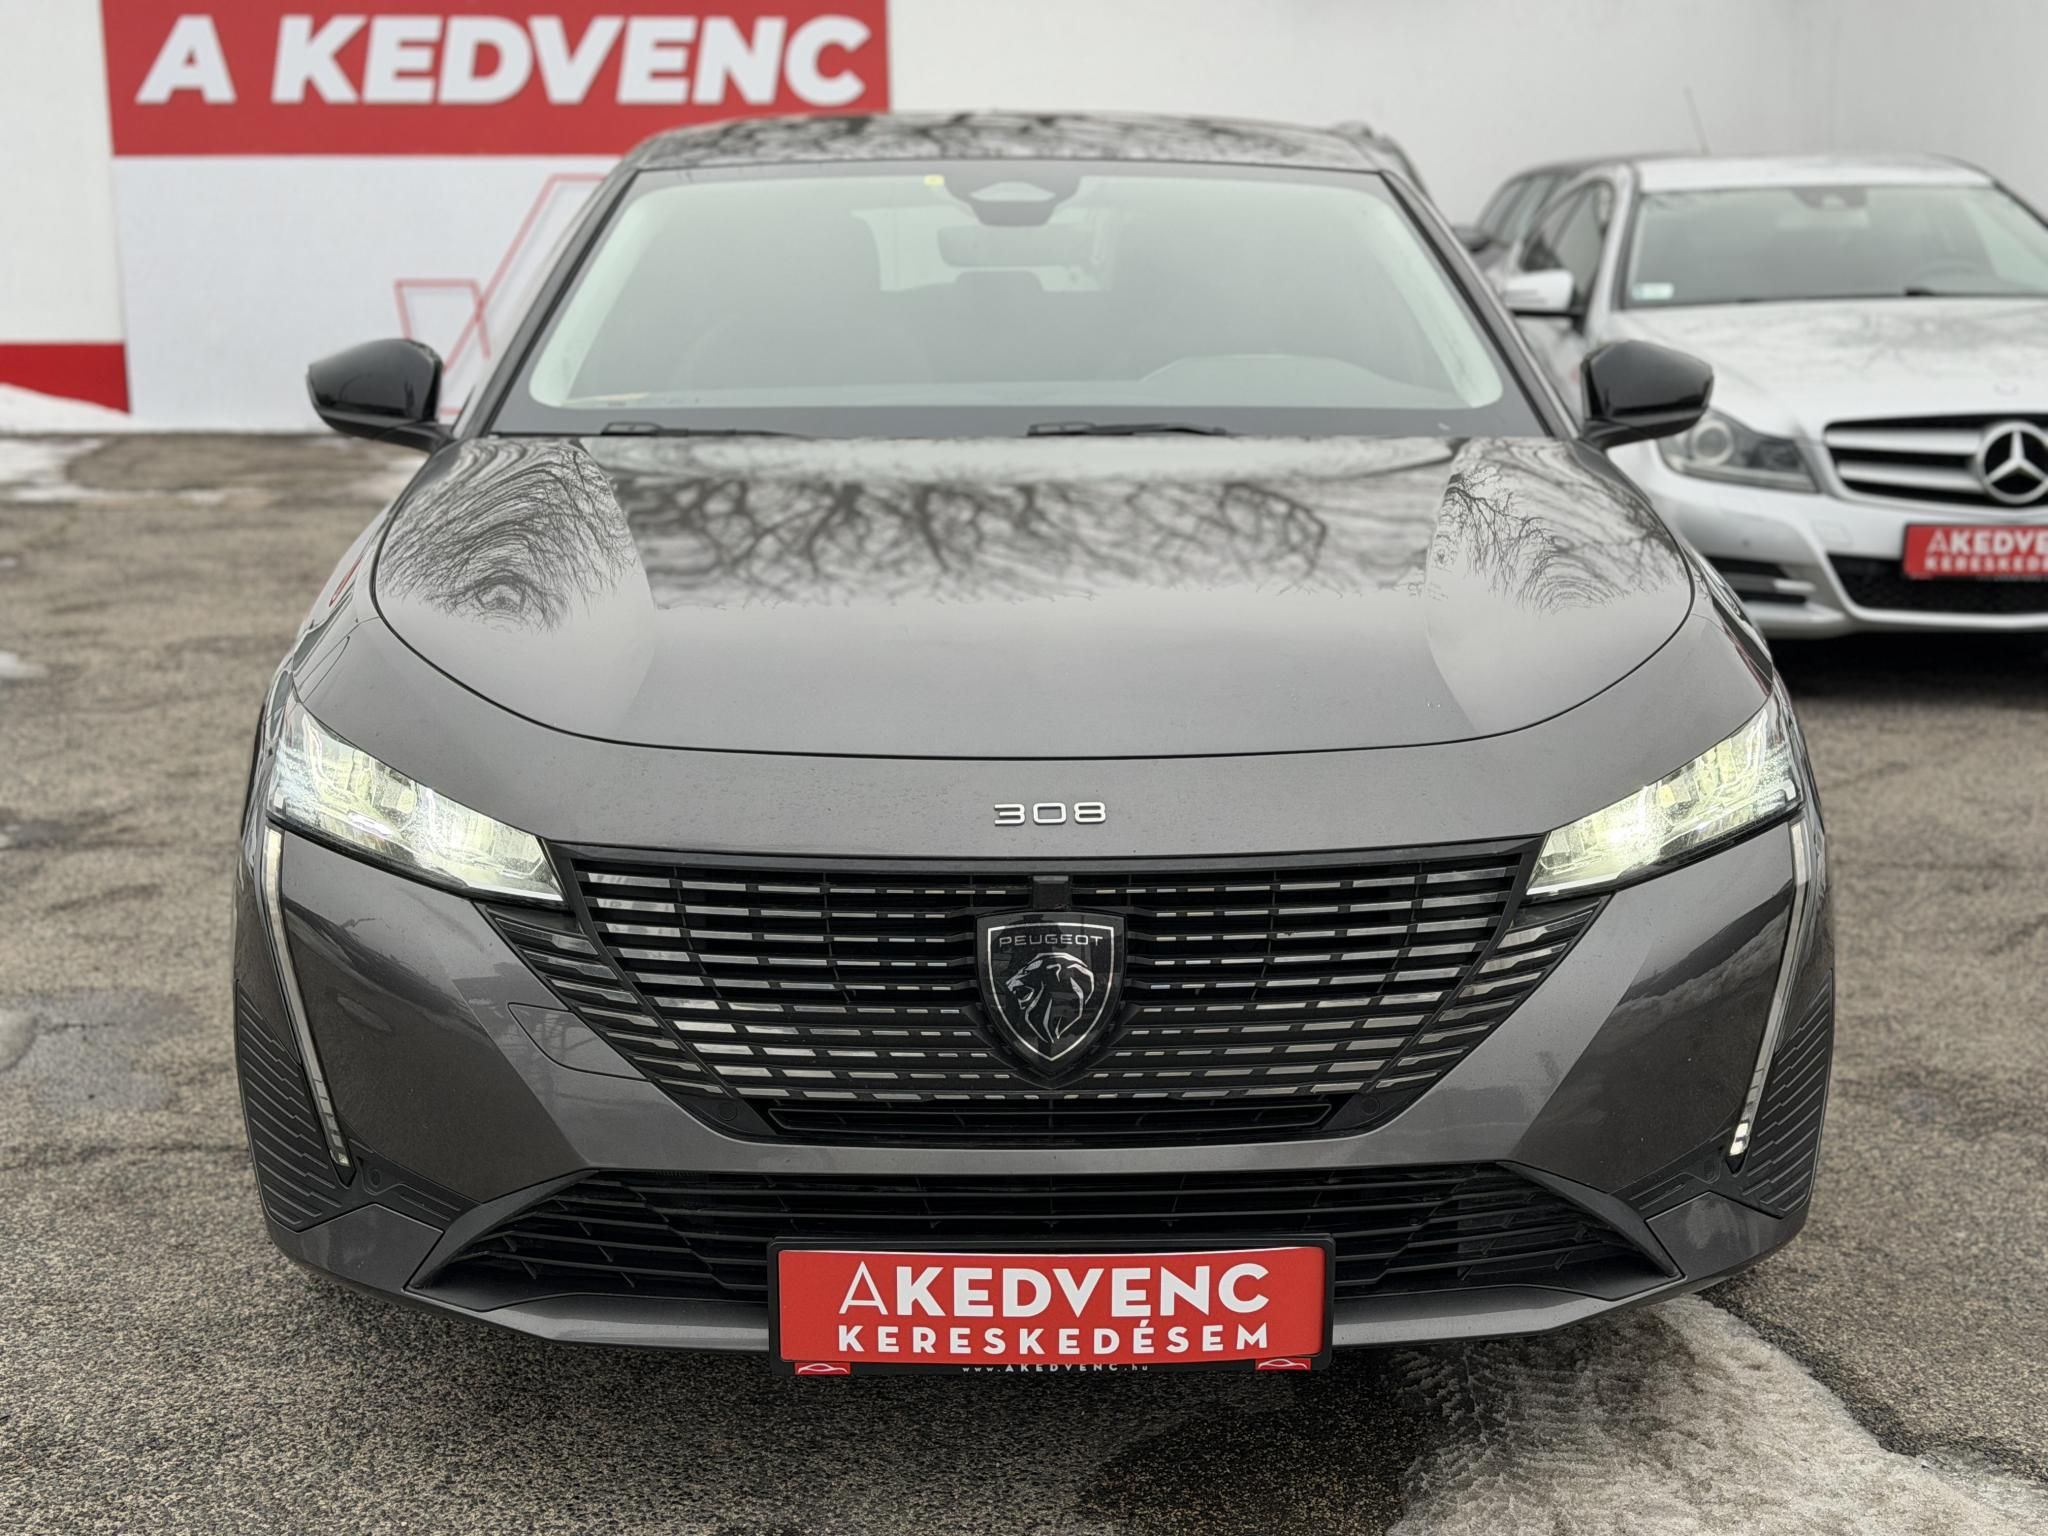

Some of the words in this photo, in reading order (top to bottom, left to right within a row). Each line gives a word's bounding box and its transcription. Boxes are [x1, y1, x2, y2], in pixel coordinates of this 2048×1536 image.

[136, 16, 237, 104] A
[271, 15, 871, 107] KEDVENC
[994, 802, 1106, 826] 308
[1000, 934, 1103, 946] PEUGEOT
[838, 1261, 1270, 1318] AKEDVENC
[838, 1321, 1269, 1355] KERESKEDÉSEM
